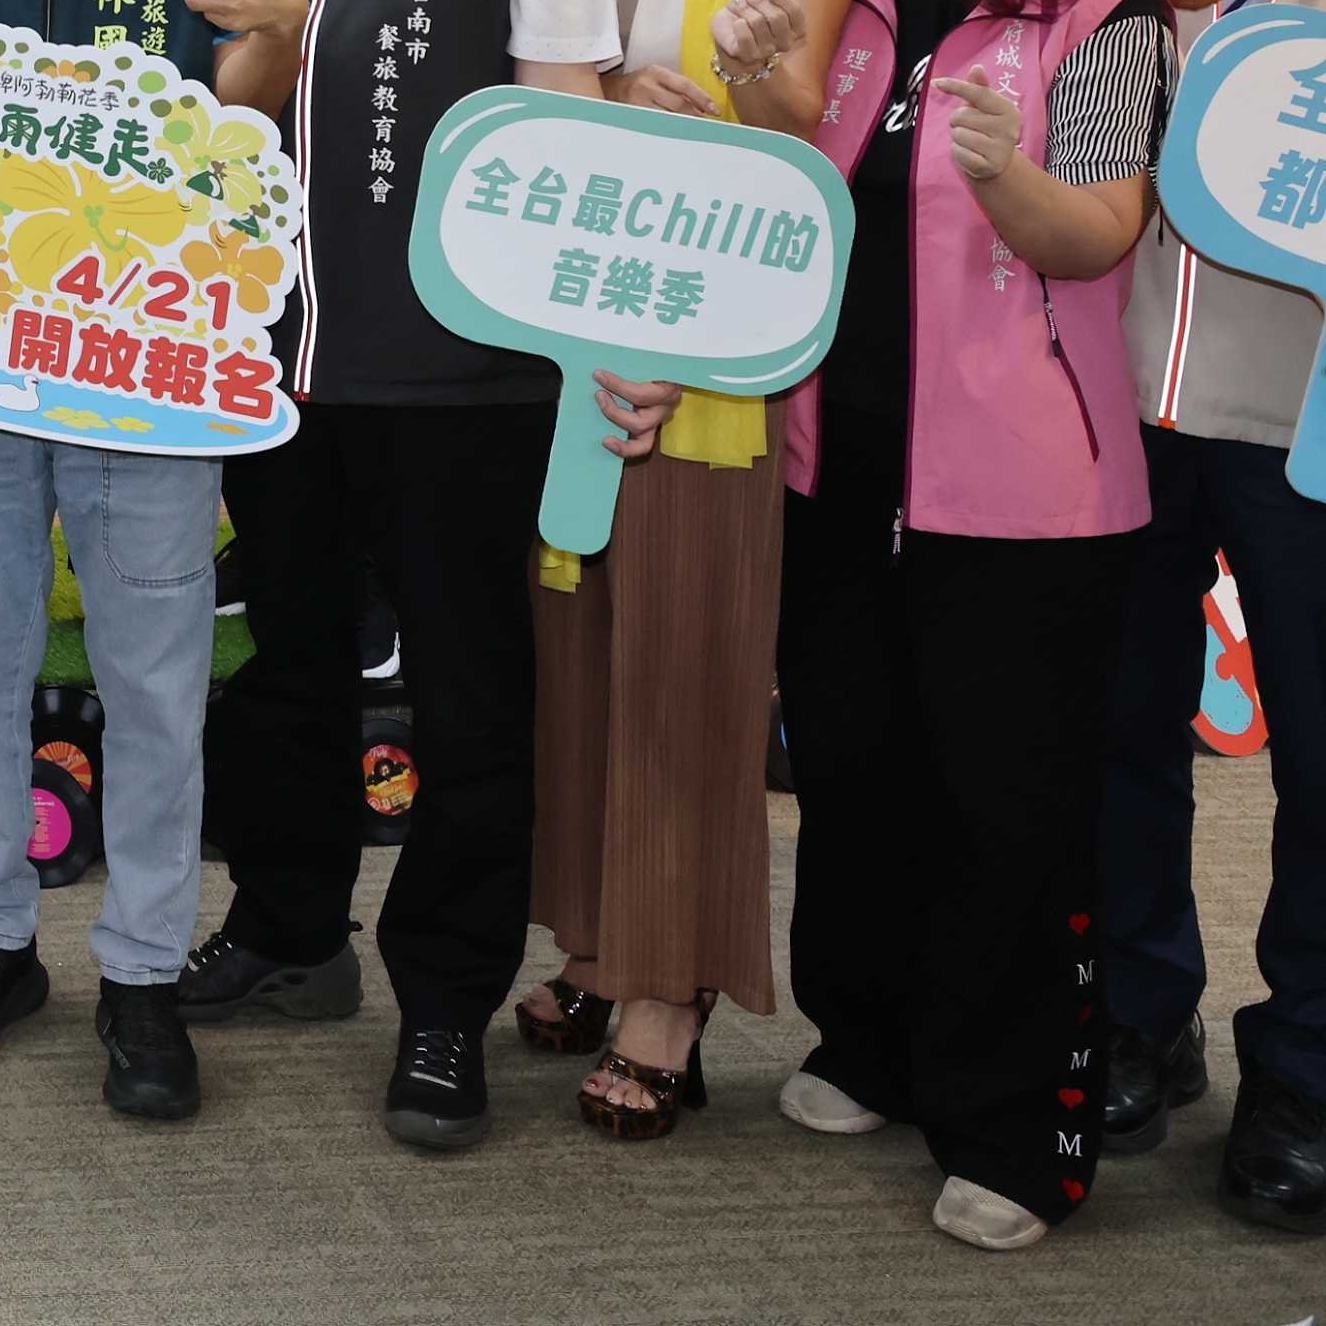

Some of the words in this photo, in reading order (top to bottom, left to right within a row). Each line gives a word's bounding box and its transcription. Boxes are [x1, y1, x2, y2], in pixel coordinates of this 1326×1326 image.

[367, 23, 402, 205] 餐旅教育協會
[822, 47, 874, 125] 理事長
[464, 155, 821, 274] 全台最Chill的
[56, 254, 234, 331] 4/21
[548, 246, 707, 326] 音樂季
[7, 307, 277, 420] 開放報名
[1076, 959, 1095, 986] M
[1070, 1048, 1092, 1071] M
[1056, 1130, 1083, 1158] M
